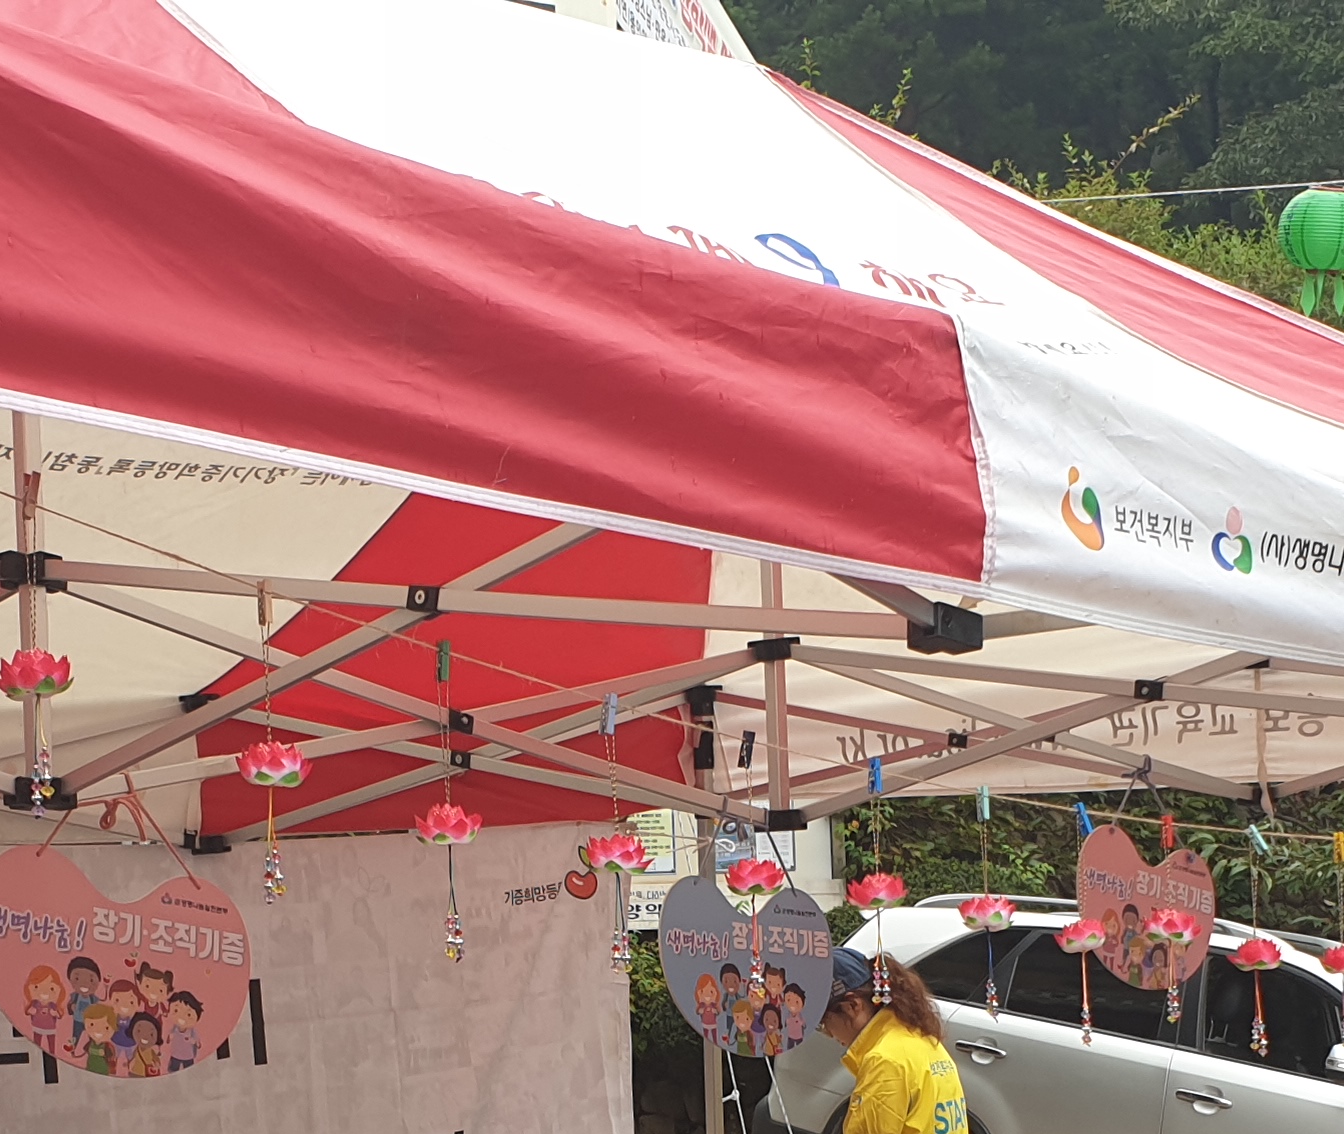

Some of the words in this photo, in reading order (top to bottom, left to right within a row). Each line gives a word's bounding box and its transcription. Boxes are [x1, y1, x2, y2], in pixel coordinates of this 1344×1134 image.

[1114, 505, 1194, 553] 보건복지부
[504, 881, 562, 906] 기증희망등
[666, 927, 730, 961] 생명나눔!
